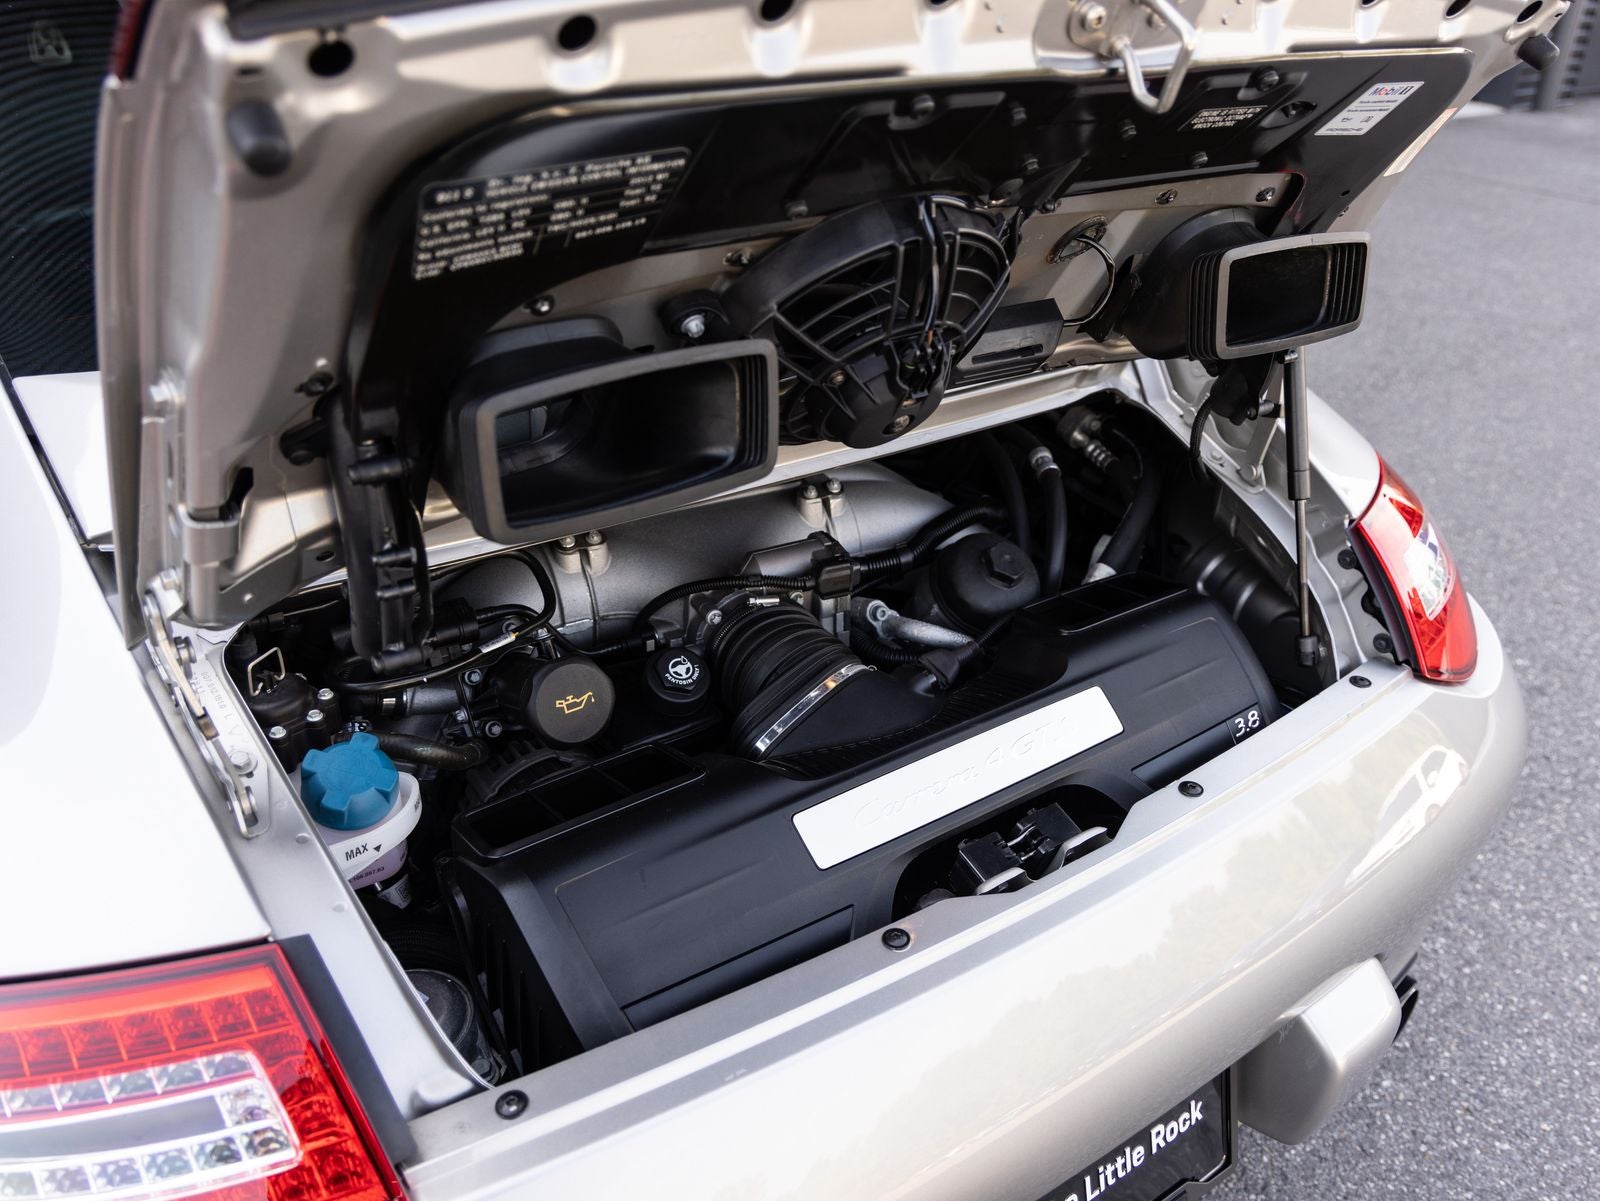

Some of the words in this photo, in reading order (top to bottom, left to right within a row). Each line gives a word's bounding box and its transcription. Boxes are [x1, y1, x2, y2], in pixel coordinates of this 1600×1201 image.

[1369, 85, 1401, 96] Mobil
[665, 672, 694, 685] PENTOSIN
[1234, 709, 1260, 738] 3.8
[345, 842, 369, 862] MAX
[1084, 1145, 1146, 1201] Little
[1150, 1099, 1204, 1155] Rock
